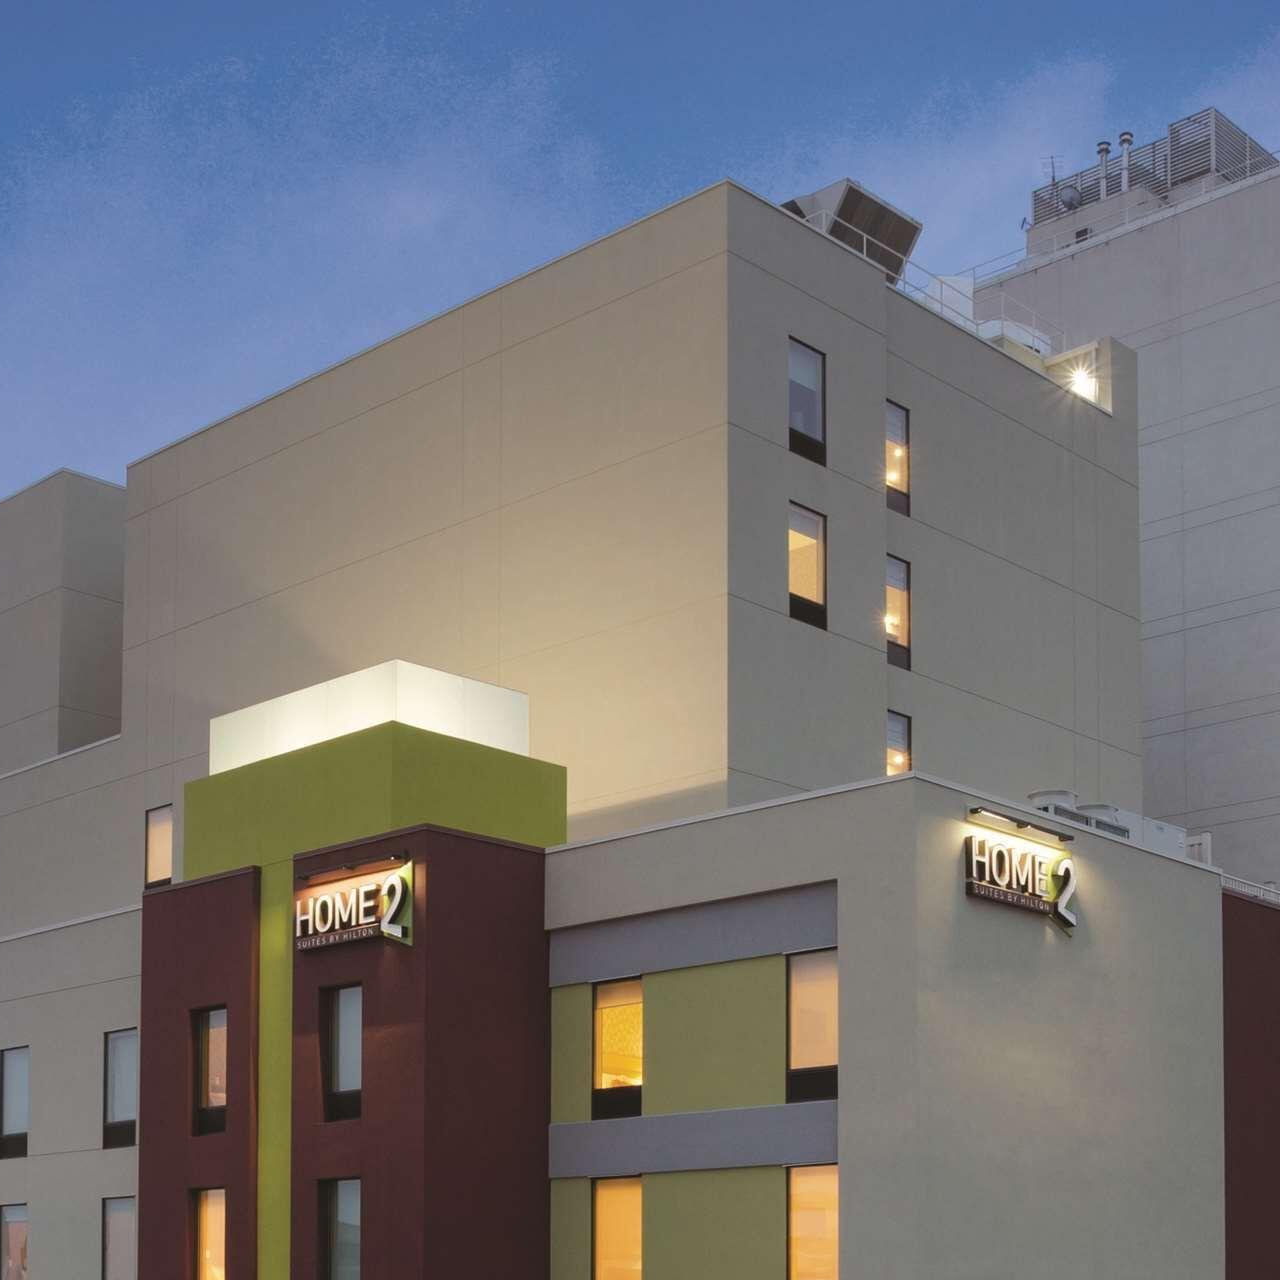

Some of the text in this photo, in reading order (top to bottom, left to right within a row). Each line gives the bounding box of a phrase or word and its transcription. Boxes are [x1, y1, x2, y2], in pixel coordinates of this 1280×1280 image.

[974, 884, 1050, 911] SUITES BY HILTON
[297, 928, 373, 949] SUITES BY HILTON
